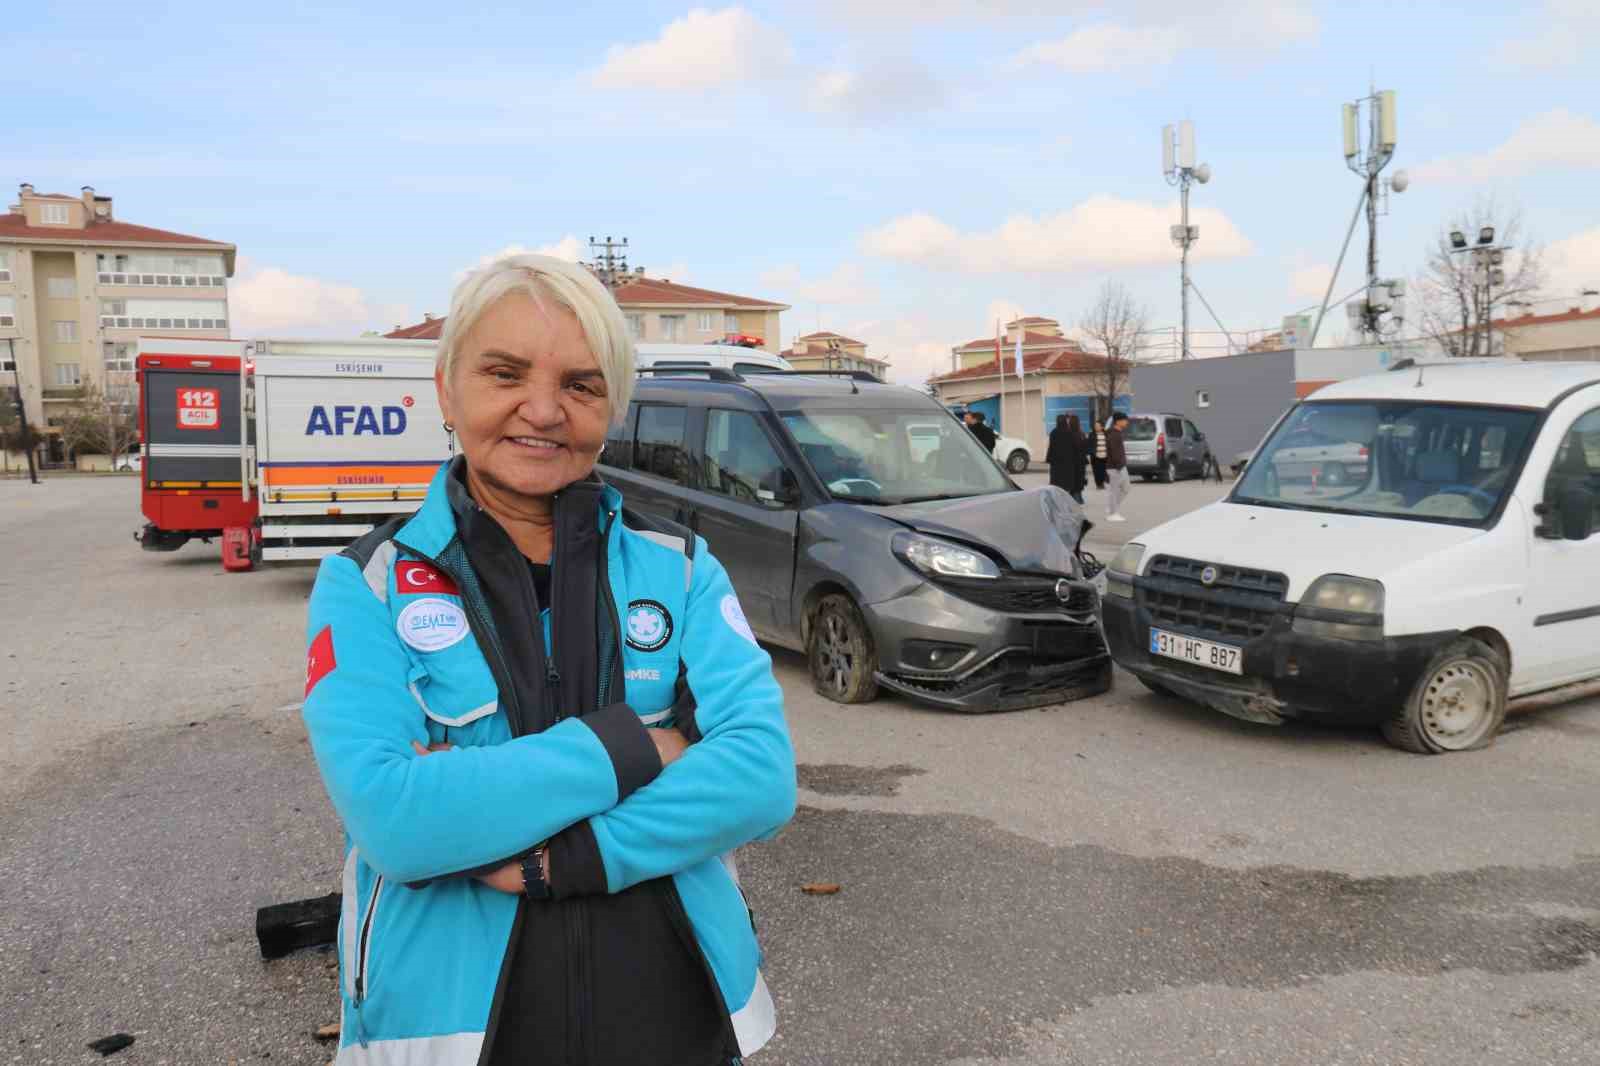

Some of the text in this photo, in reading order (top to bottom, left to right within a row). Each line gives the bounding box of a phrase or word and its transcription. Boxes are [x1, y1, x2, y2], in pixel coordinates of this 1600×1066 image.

[182, 391, 215, 407] 112
[305, 405, 407, 435] AFAD
[1160, 634, 1236, 669] 31 HC 887
